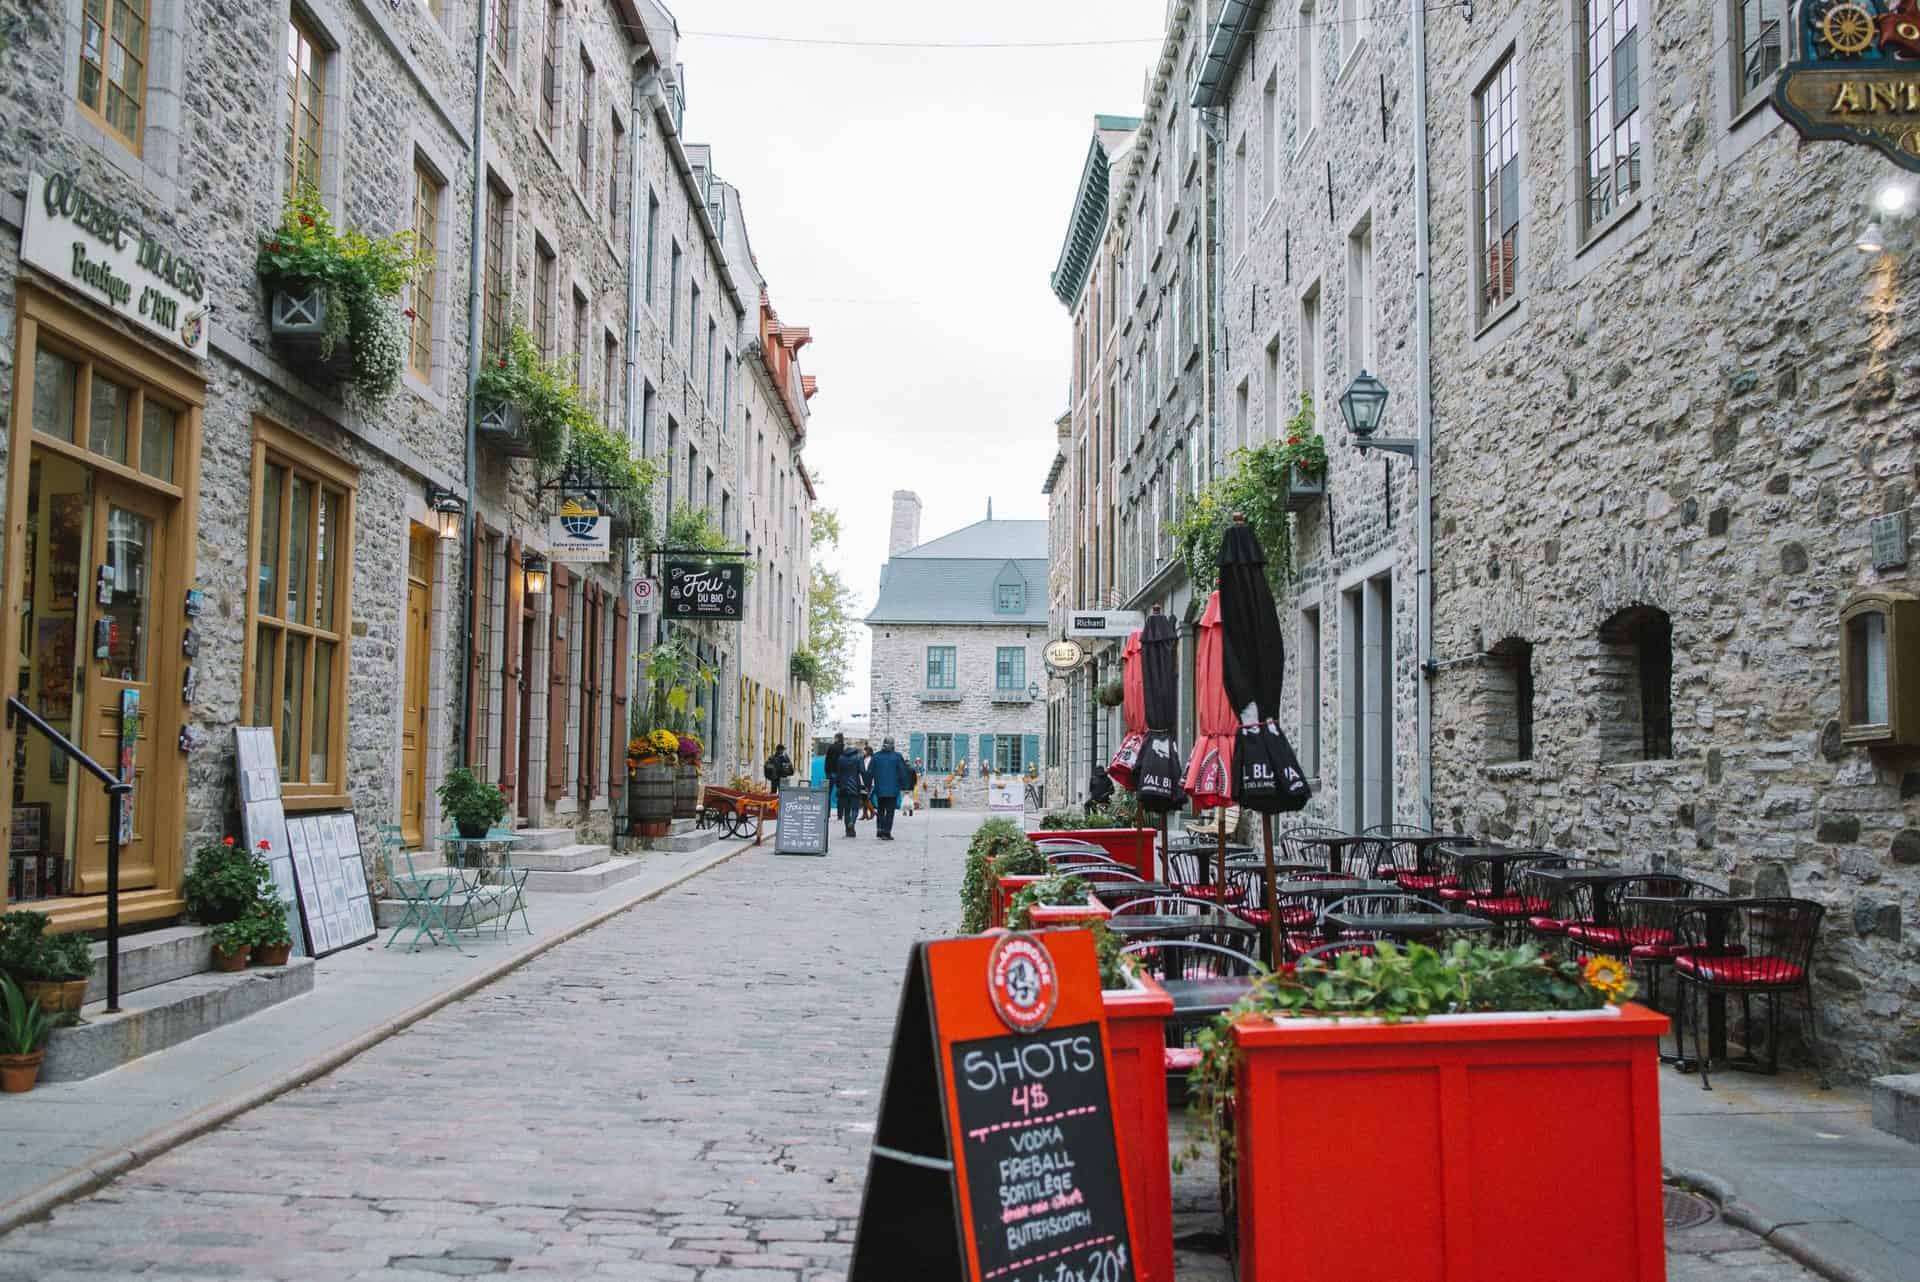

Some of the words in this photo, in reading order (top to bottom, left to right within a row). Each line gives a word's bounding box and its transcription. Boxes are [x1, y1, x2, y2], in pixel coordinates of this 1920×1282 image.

[72, 241, 131, 305] Boutique
[136, 227, 206, 302] IMAGES
[683, 570, 723, 597] Fou
[698, 593, 709, 603] DU
[711, 593, 723, 604] BIO
[1076, 618, 1104, 628] Richard
[964, 1037, 1095, 1091] SHOTS
[1011, 1083, 1049, 1116] 4$
[1010, 1126, 1063, 1152] VODKA
[999, 1152, 1075, 1182] FIREBALL
[1006, 1209, 1092, 1250] BUTTERSCOTCH
